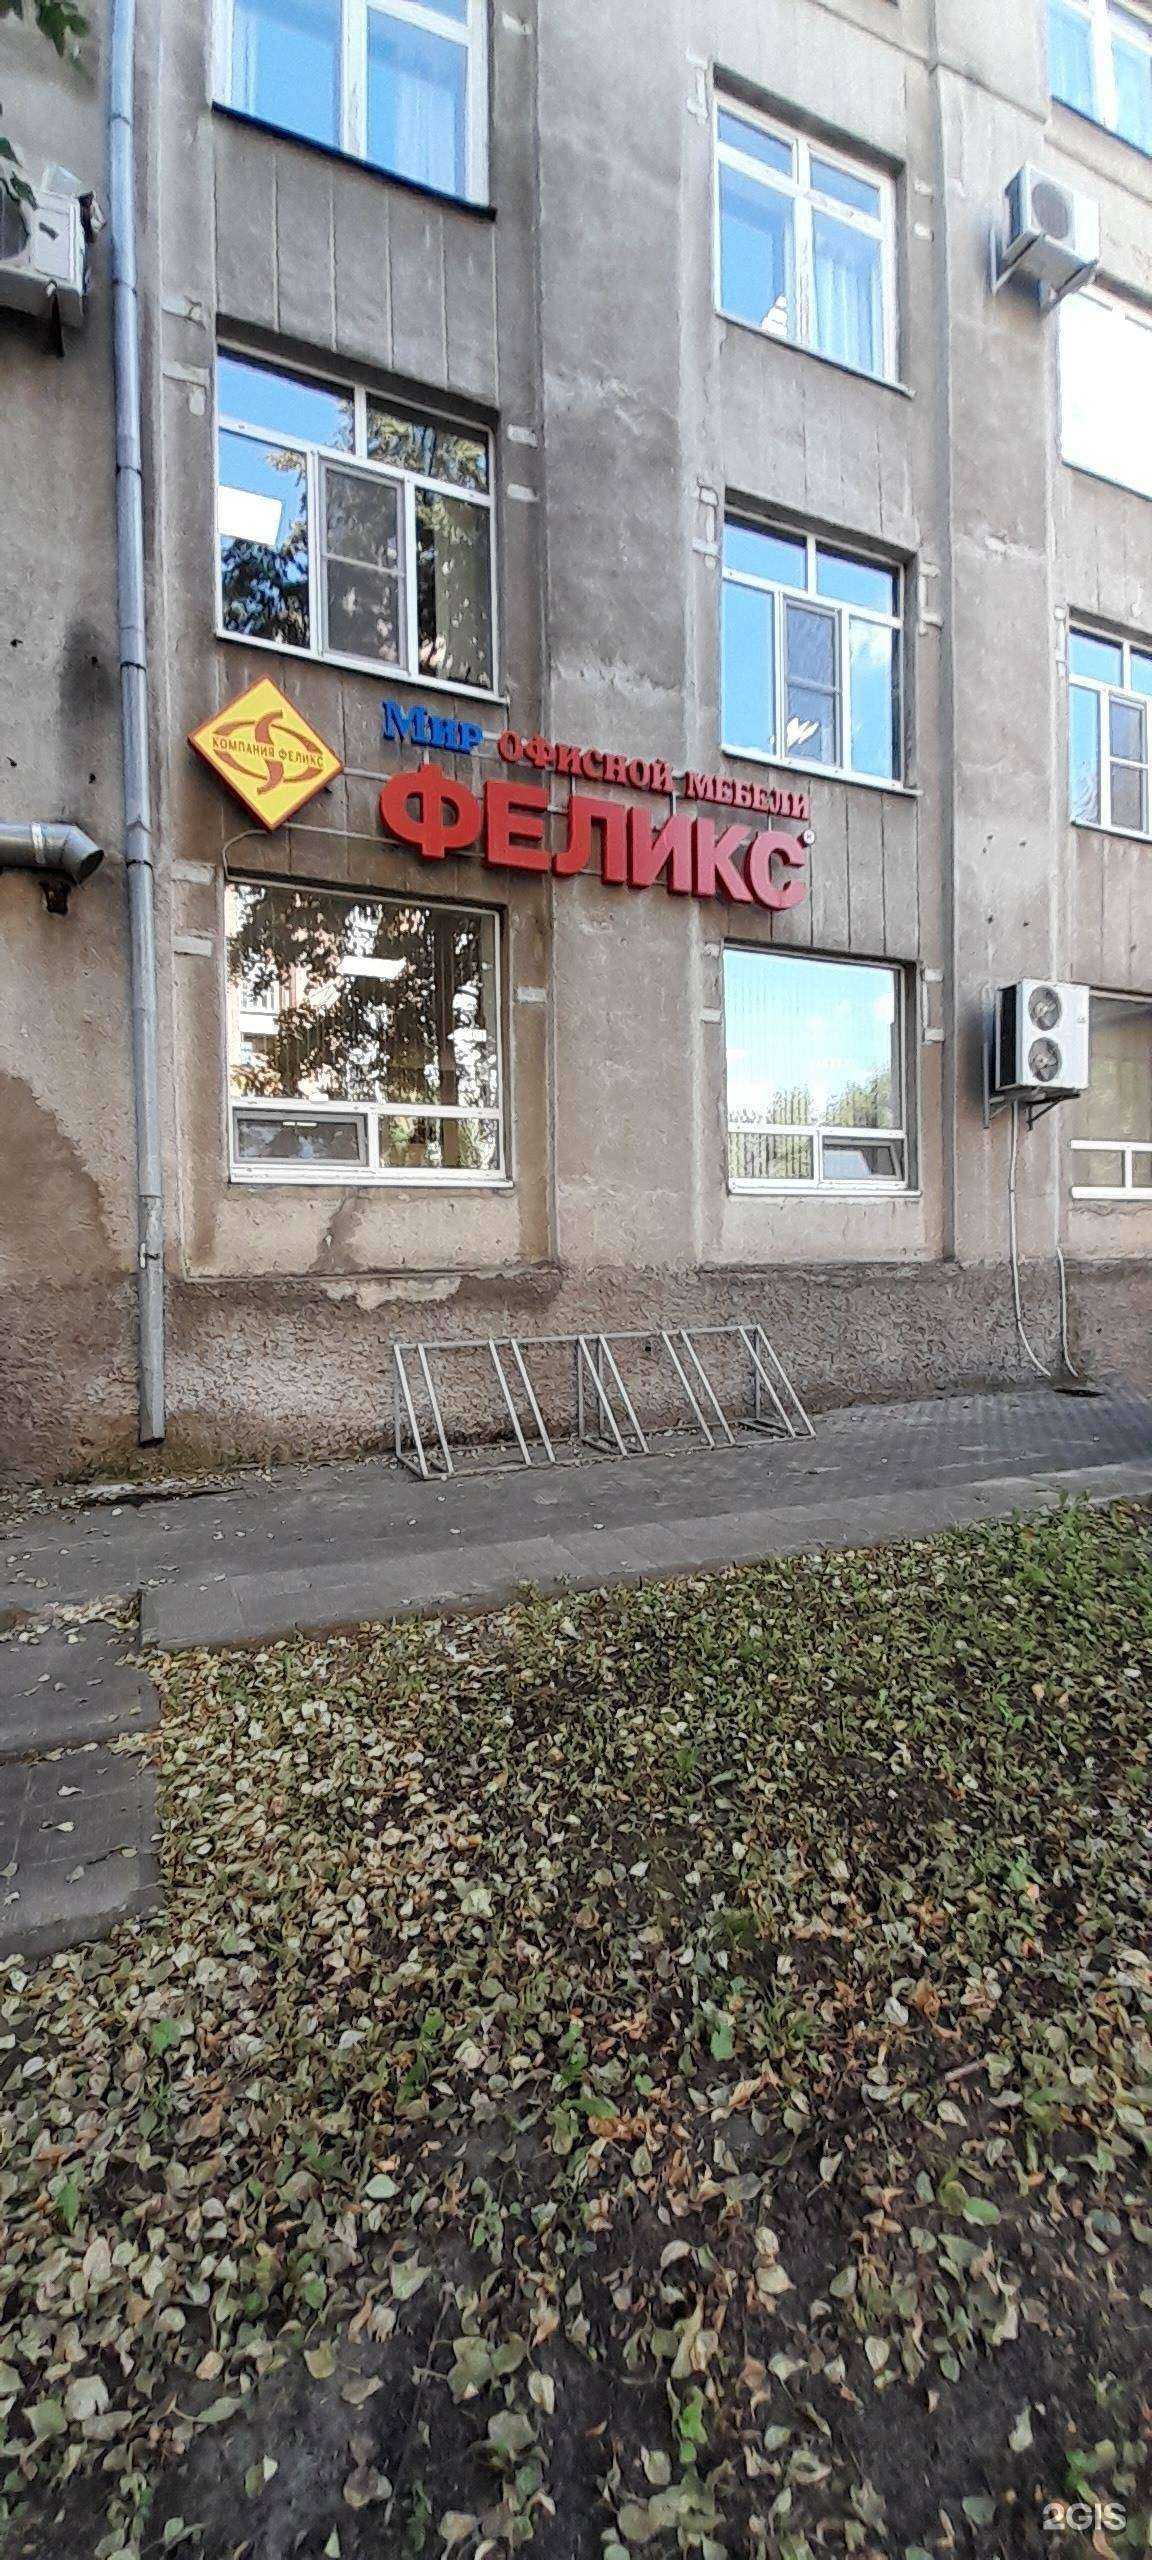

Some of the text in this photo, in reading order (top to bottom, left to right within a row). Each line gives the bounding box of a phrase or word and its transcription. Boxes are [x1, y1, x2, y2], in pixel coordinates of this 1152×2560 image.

[212, 736, 324, 767] КОМПАНИЯ ФЕЛИКС
[497, 730, 674, 794] ОФИСНОЙ
[684, 770, 809, 821] МЕБЕЛИ
[379, 762, 807, 911] ФЕЛИКС
